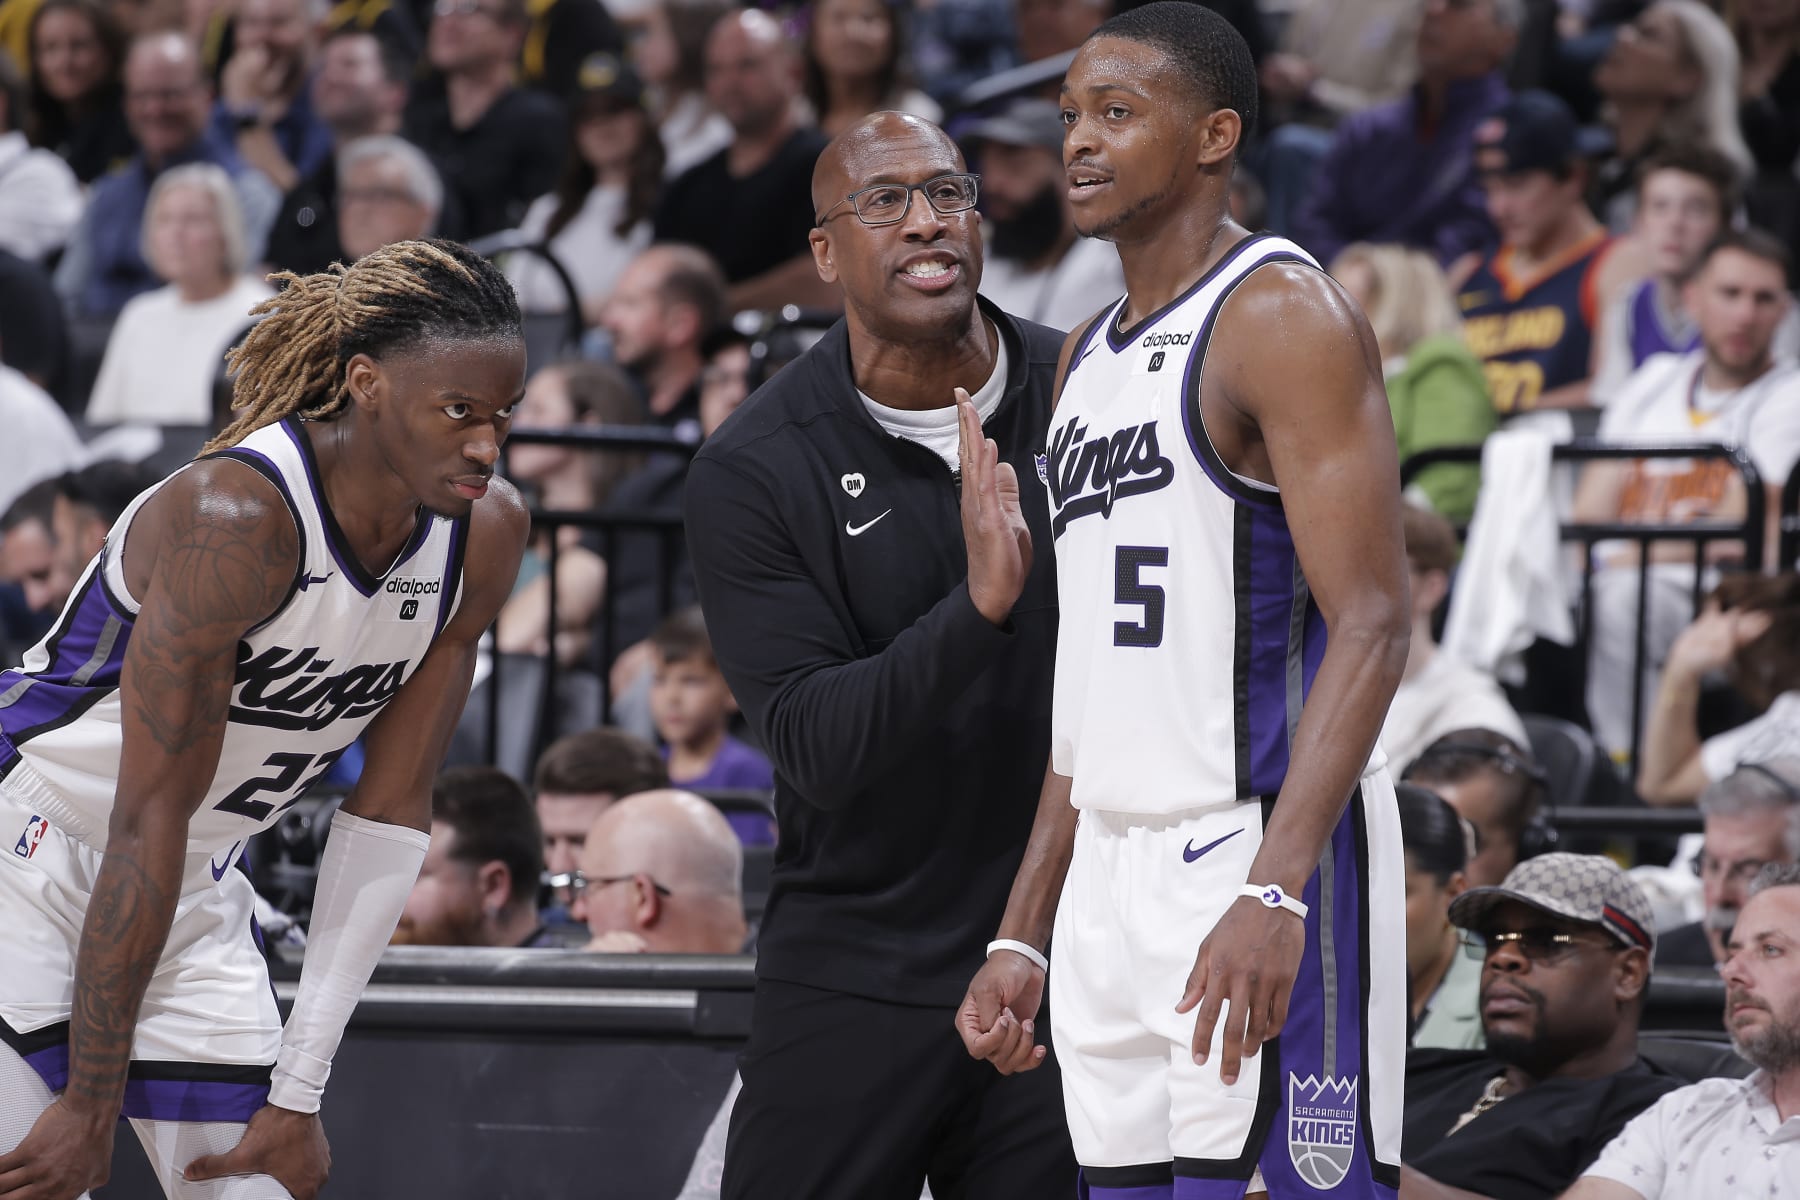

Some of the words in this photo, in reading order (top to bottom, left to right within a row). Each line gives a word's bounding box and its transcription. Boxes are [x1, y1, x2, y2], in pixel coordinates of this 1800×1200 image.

[1143, 330, 1193, 350] dialpad
[847, 479, 861, 490] DM
[1046, 416, 1175, 541] Kings
[386, 577, 440, 598] dialpad
[1113, 545, 1168, 648] 5
[229, 640, 412, 731] Kings
[1295, 1106, 1354, 1119] SACRAMENTO
[1291, 1120, 1354, 1146] KINGS
